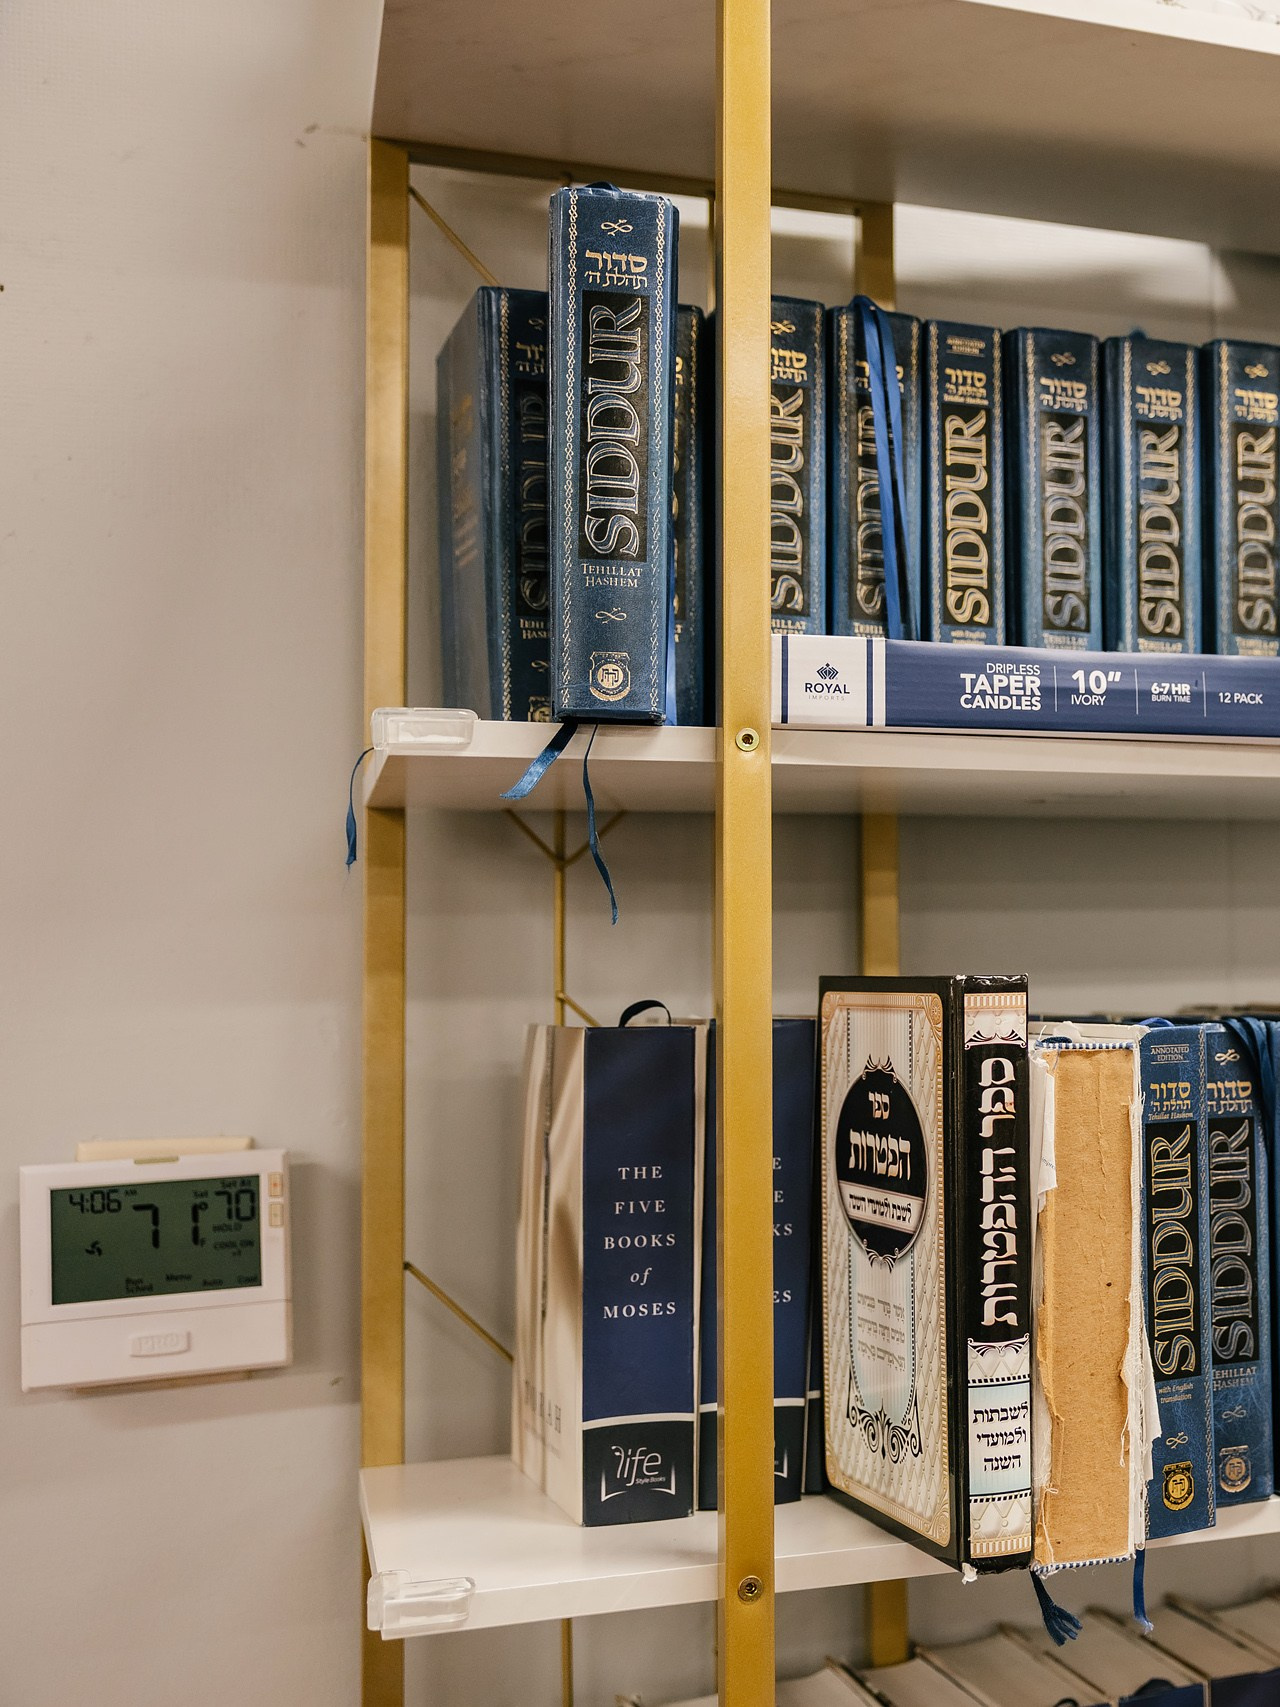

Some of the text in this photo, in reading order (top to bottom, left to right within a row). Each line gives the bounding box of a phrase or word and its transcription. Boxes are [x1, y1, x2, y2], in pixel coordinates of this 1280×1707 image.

[585, 249, 648, 273] סדור
[585, 297, 642, 558] SIDDUR
[945, 410, 989, 625] SIDDUR
[1044, 417, 1084, 633] SIDDUR
[1140, 425, 1180, 636] SIDDUR
[1236, 426, 1276, 633] SIDDUR
[581, 563, 643, 577] TEHILLAT
[585, 576, 638, 588] HASHEM
[986, 662, 1041, 676] DRIPLESS
[805, 682, 850, 694] ROYAL
[960, 673, 1041, 696] TAPER
[1173, 683, 1191, 695] HR
[960, 694, 1041, 711] CANDLES
[1071, 694, 1107, 706] IVORY
[1151, 694, 1191, 703] BURN TIME
[1218, 692, 1264, 705] 12 PACK
[1157, 1053, 1184, 1062] EDITION
[978, 1057, 1016, 1138] ספר
[1150, 1082, 1191, 1099] סדור
[1207, 1080, 1252, 1099] סדור
[869, 1091, 890, 1120] ספר
[849, 1129, 911, 1181] הפטרות
[618, 1166, 663, 1180] THE
[214, 1188, 256, 1221] 70
[614, 1200, 666, 1215] FIVE
[603, 1233, 676, 1250] BOOKS
[1150, 1124, 1197, 1376] SIDDUR
[1211, 1119, 1254, 1362] SIDDUR
[630, 1267, 652, 1286] of
[603, 1301, 676, 1319] MOSES
[972, 1401, 1028, 1423] לשבתות
[976, 1426, 1027, 1447] ולמועדי
[984, 1454, 1021, 1471] השנה
